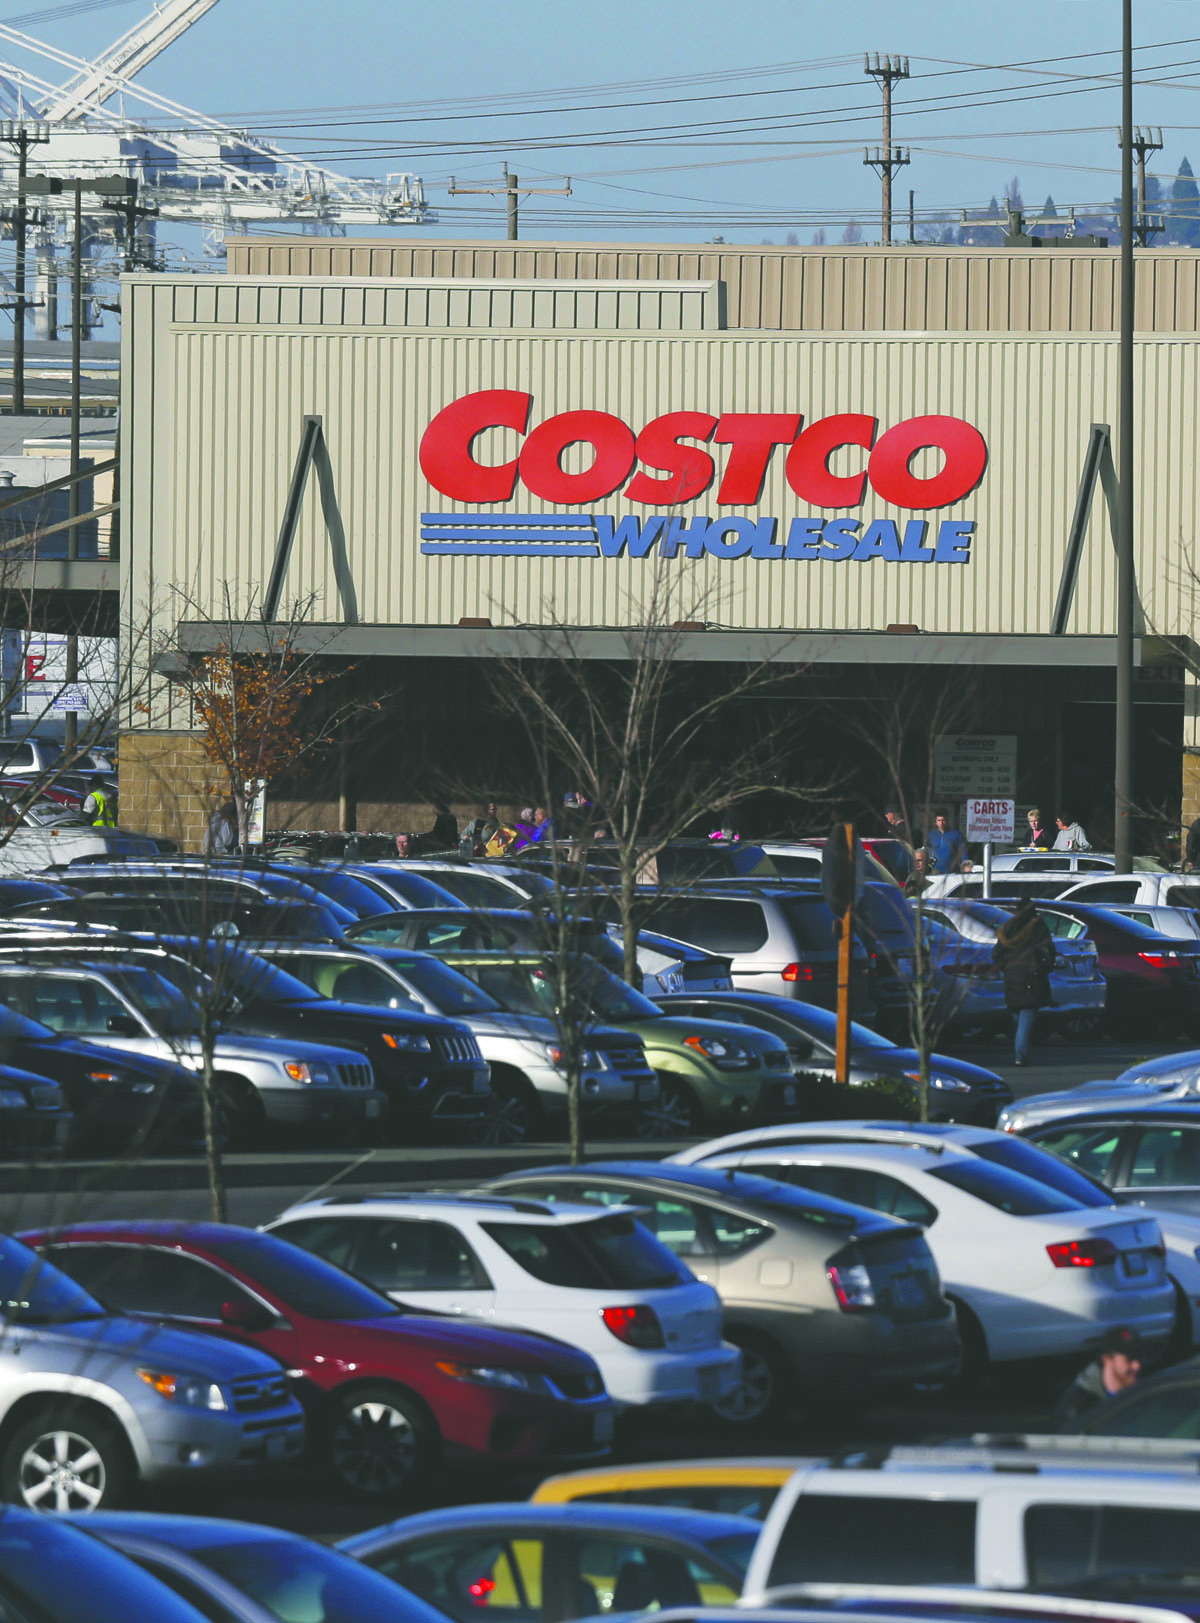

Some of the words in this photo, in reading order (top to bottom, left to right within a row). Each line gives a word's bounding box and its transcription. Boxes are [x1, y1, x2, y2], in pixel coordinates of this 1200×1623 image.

[418, 388, 988, 509] COSTCO
[593, 514, 977, 563] WHOLESALE
[1138, 665, 1185, 681] EXIT
[974, 801, 1008, 815] CARTS
